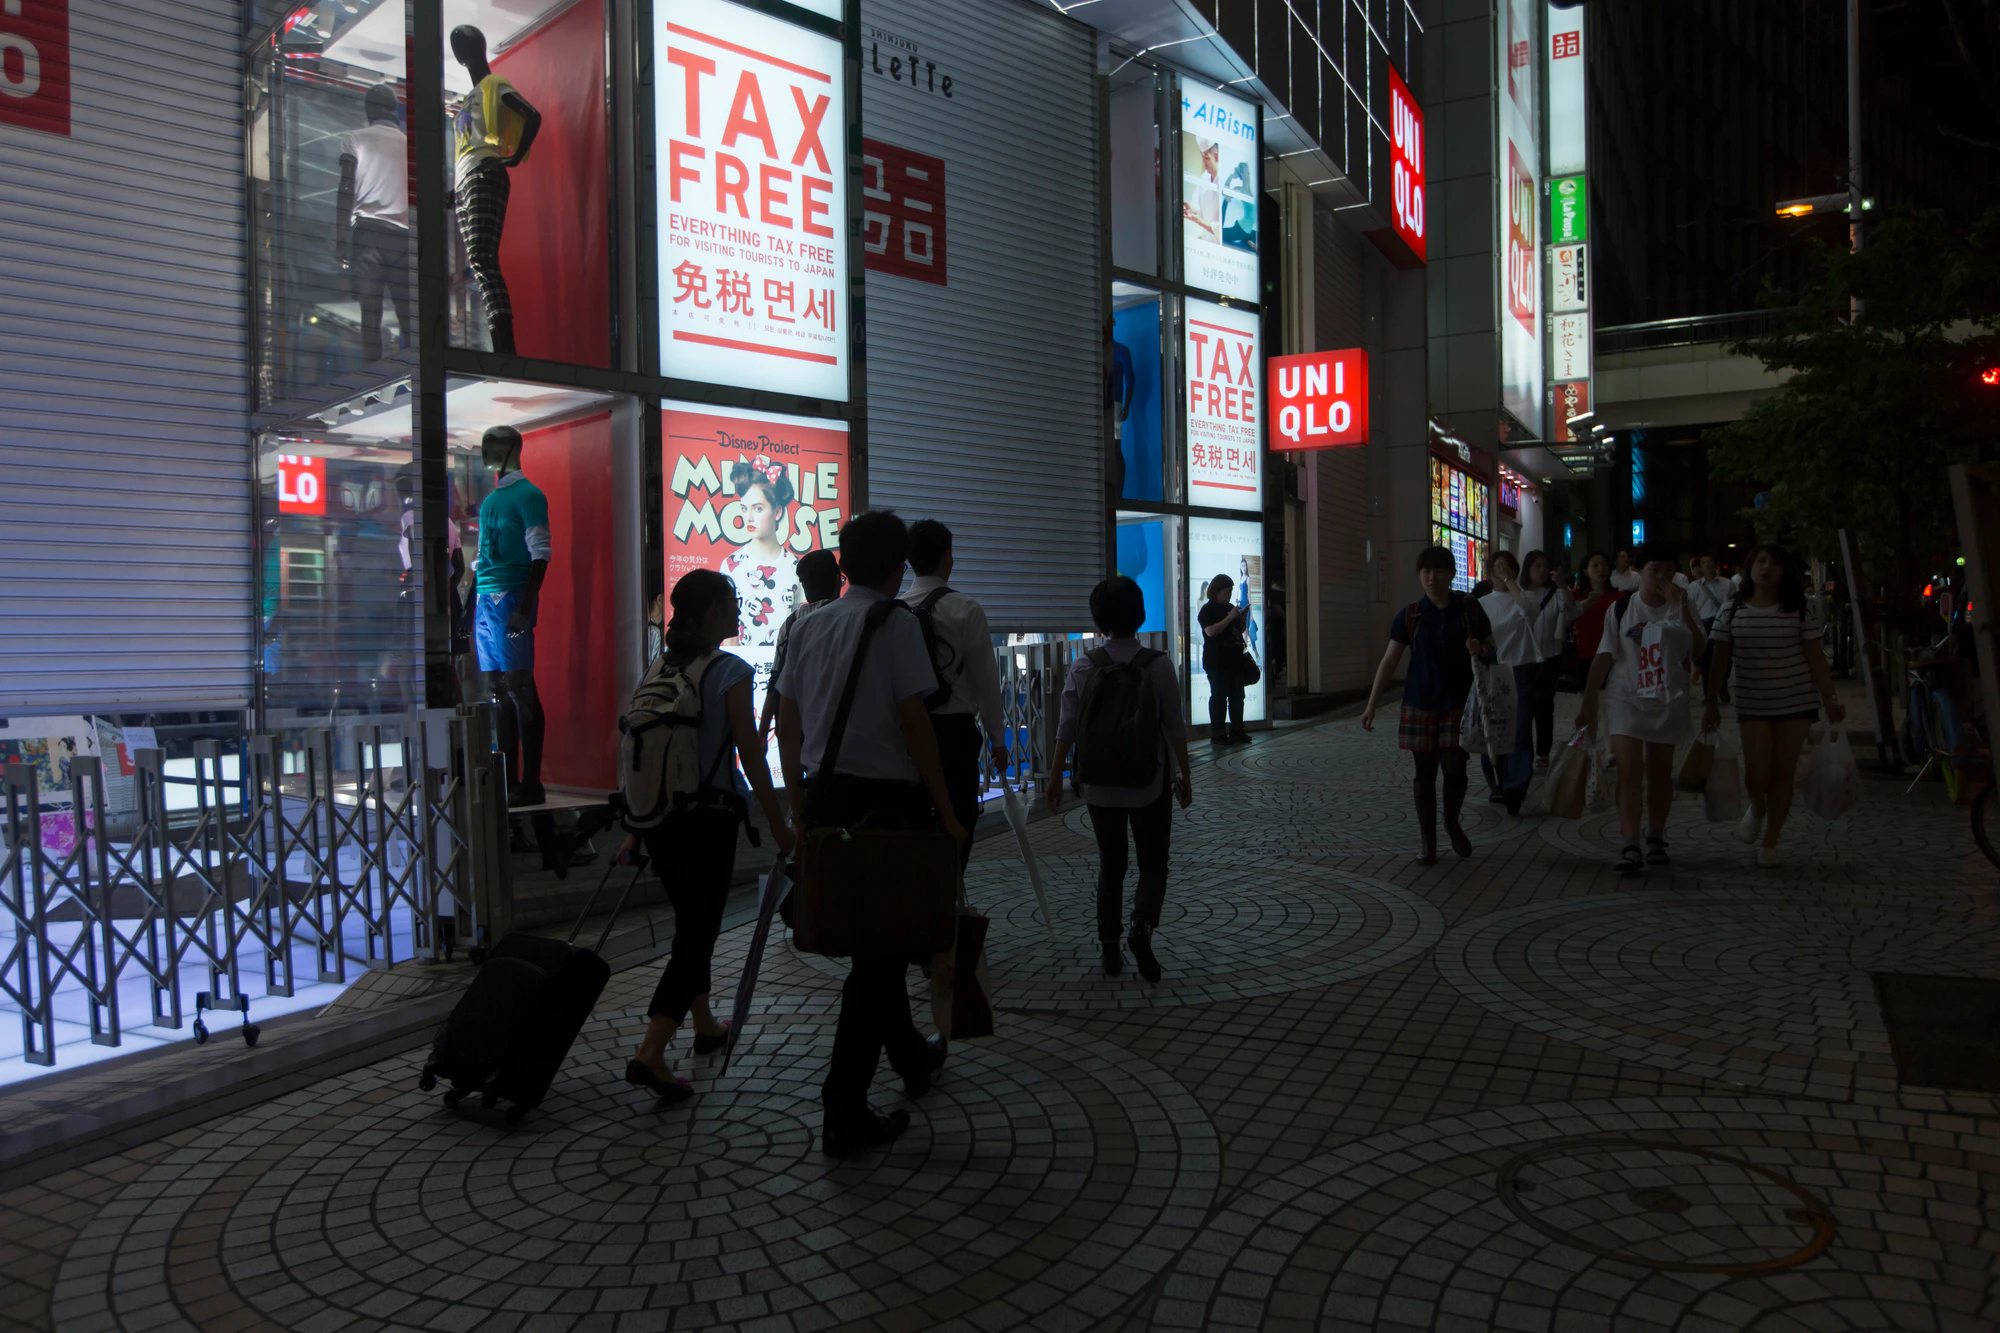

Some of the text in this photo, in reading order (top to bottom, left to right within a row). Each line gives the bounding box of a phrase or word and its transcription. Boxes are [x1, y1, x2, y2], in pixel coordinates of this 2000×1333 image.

[870, 28, 919, 53] SHINJUKU
[861, 42, 953, 99] LeTTe
[667, 45, 833, 176] TAX
[1392, 88, 1421, 175] UNI
[669, 139, 835, 240] FREE
[1393, 159, 1424, 239] QLO
[1511, 165, 1533, 248] UNI
[669, 213, 835, 265] EVERYTHING TAX FREE
[669, 233, 835, 279] FOR VISITING TOURISTS TO JAPAN
[671, 259, 754, 318] 免税
[1511, 238, 1534, 313] QLO
[763, 278, 836, 332] 면세
[1189, 331, 1254, 389] TAX
[1279, 361, 1344, 399] UNI
[1190, 379, 1256, 424] FREE
[1279, 400, 1352, 443] QLO
[716, 430, 801, 456] Disney Project
[1190, 418, 1256, 438] EVERYTHING TAX FREE
[1190, 429, 1200, 438] FOR
[1200, 431, 1216, 440] VISITING
[1217, 433, 1236, 442] TOURISTS
[1243, 437, 1256, 446] JAPAN
[670, 451, 839, 507] MIIE
[1191, 442, 1224, 470] 免税
[1227, 447, 1256, 475] 면세
[669, 554, 709, 565] 今年の気分は
